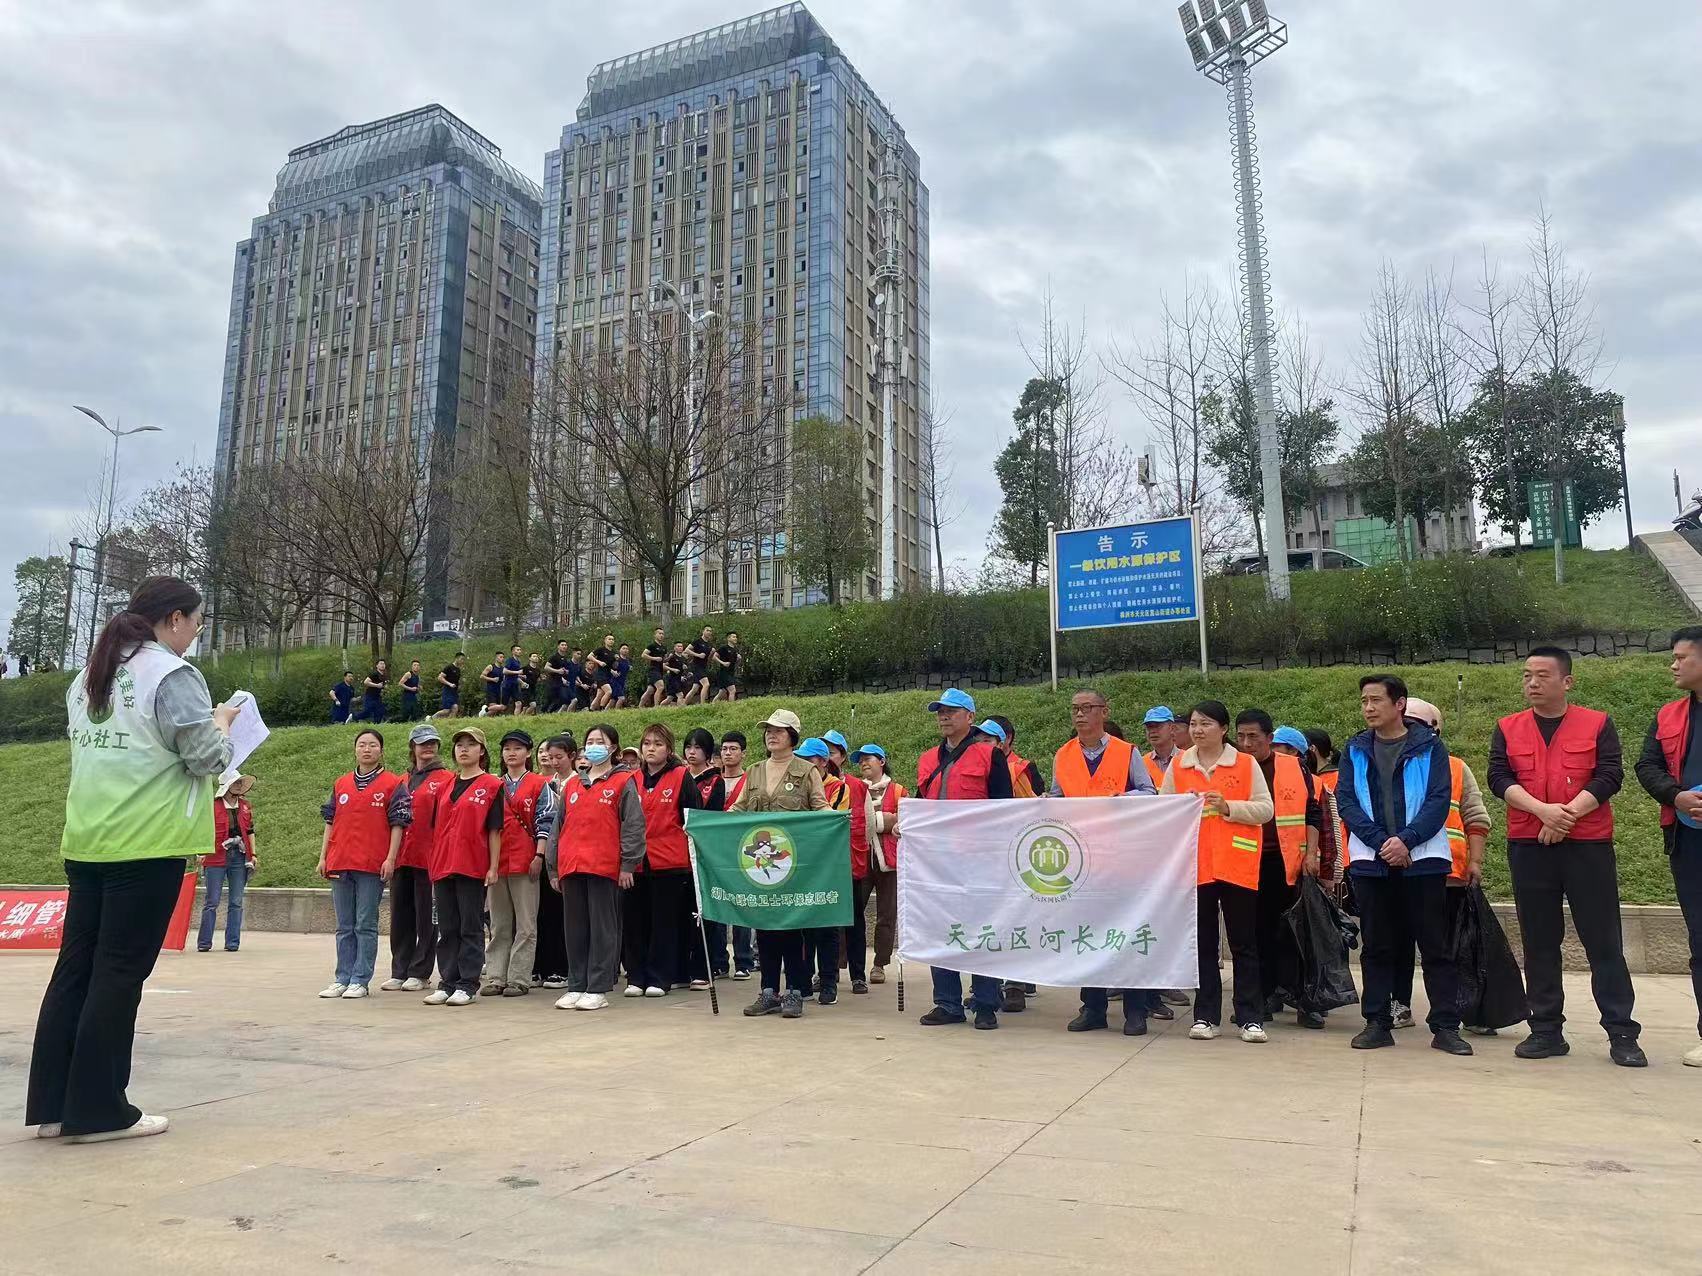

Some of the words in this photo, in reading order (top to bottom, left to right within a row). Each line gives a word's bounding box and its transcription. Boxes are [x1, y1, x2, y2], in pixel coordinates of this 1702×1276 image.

[1069, 550, 1181, 572] 一级饮用水源保护区
[0, 899, 67, 926] 细管
[946, 922, 1158, 956] 天元区河长助手
